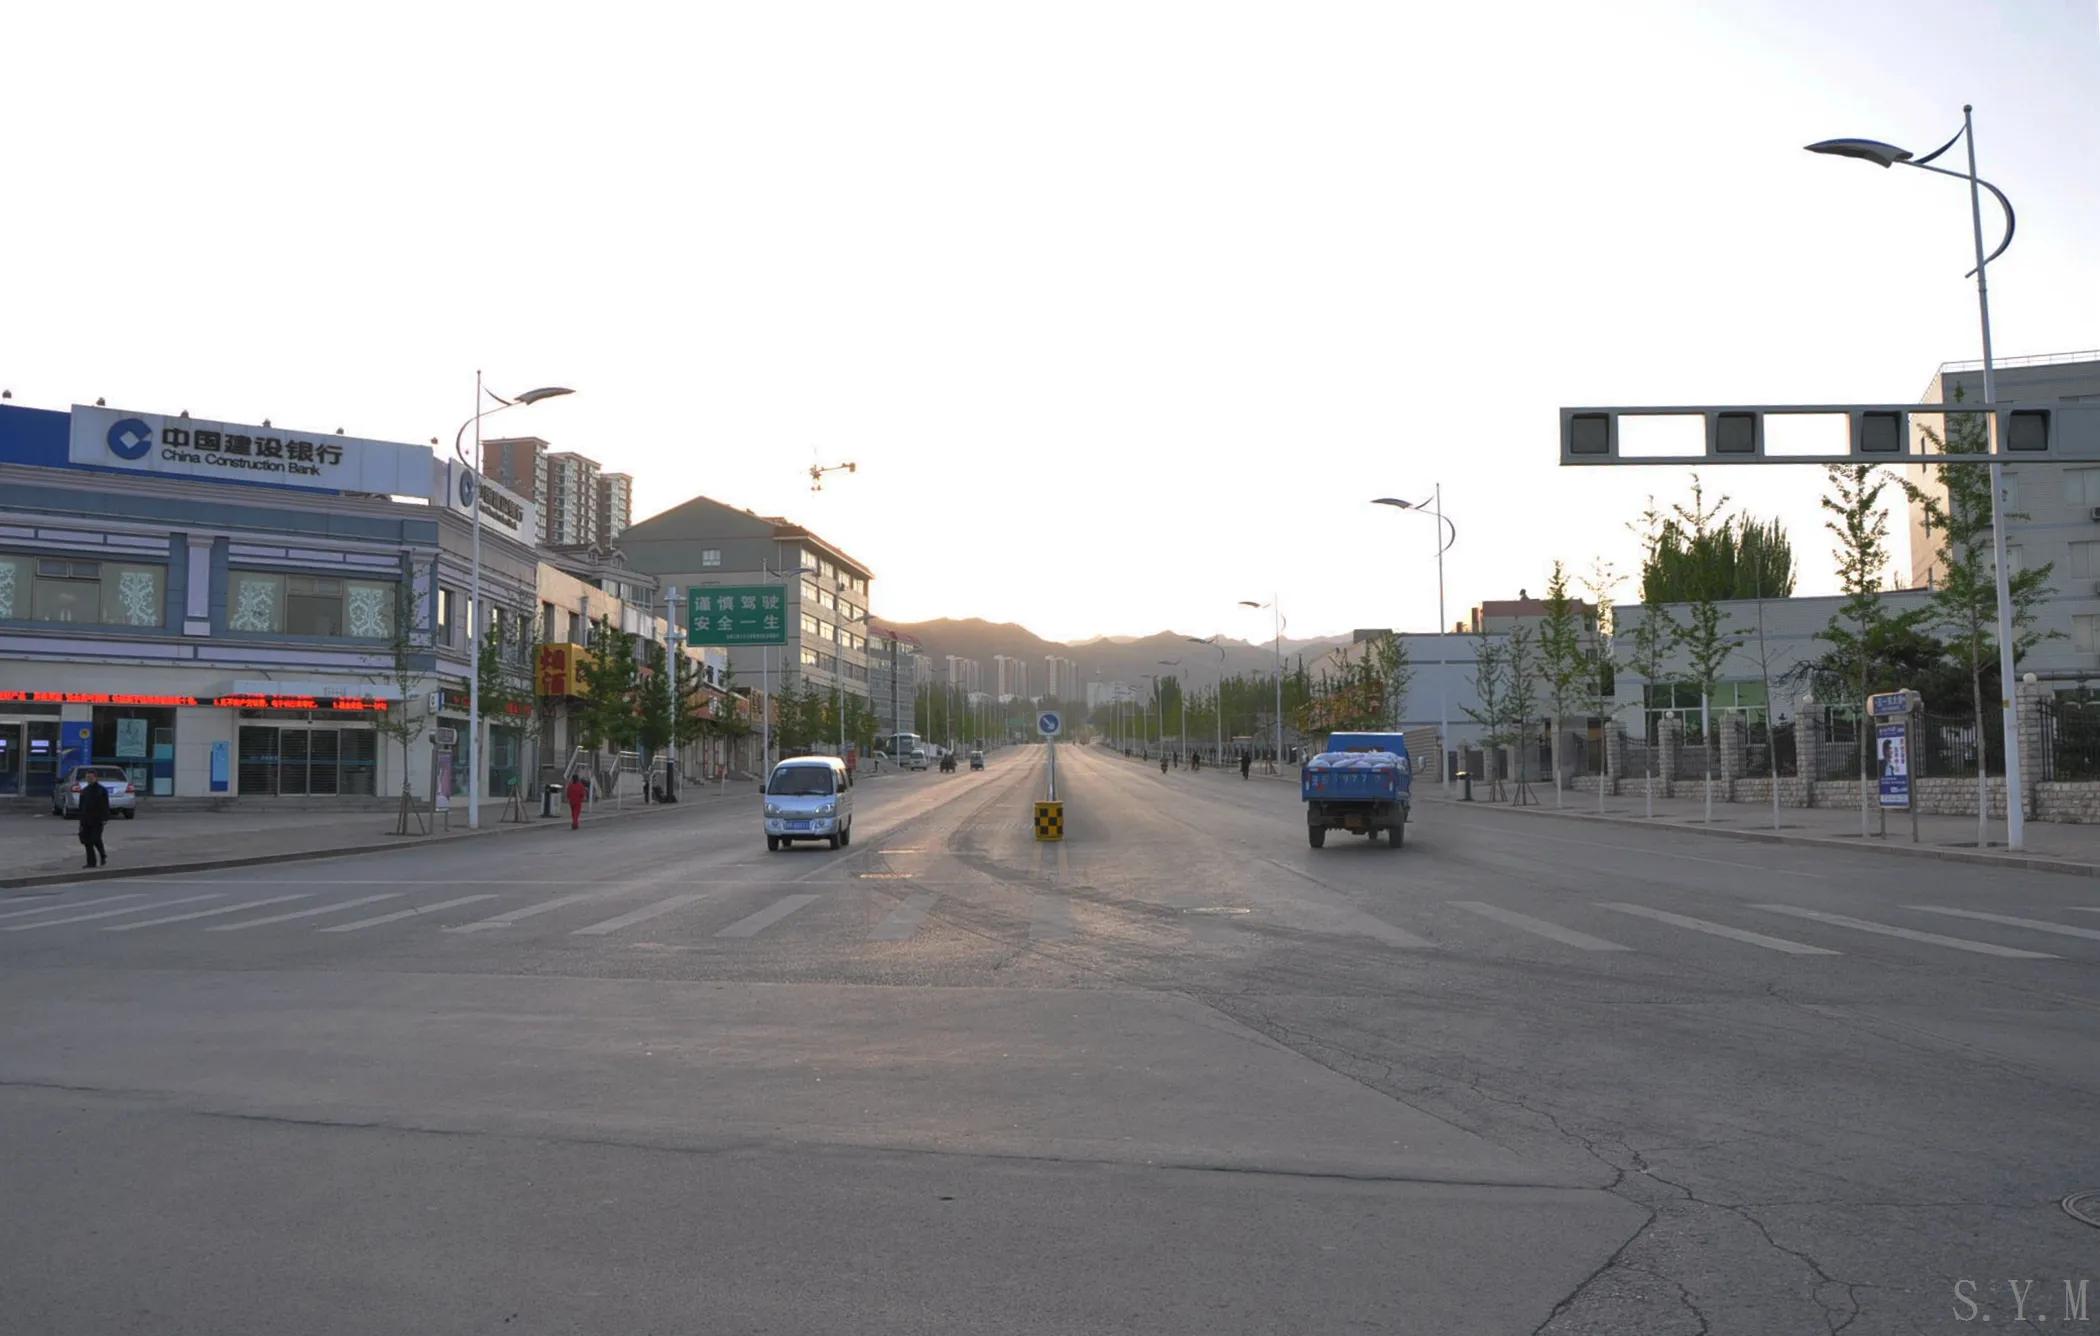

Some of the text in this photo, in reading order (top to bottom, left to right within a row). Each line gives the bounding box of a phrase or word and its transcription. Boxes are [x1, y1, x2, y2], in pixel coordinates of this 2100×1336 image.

[162, 428, 343, 465] 中国建设银行
[161, 448, 321, 476] China Construction Bank
[693, 594, 780, 611] 谨慎驾驶
[693, 614, 780, 631] 安全一生
